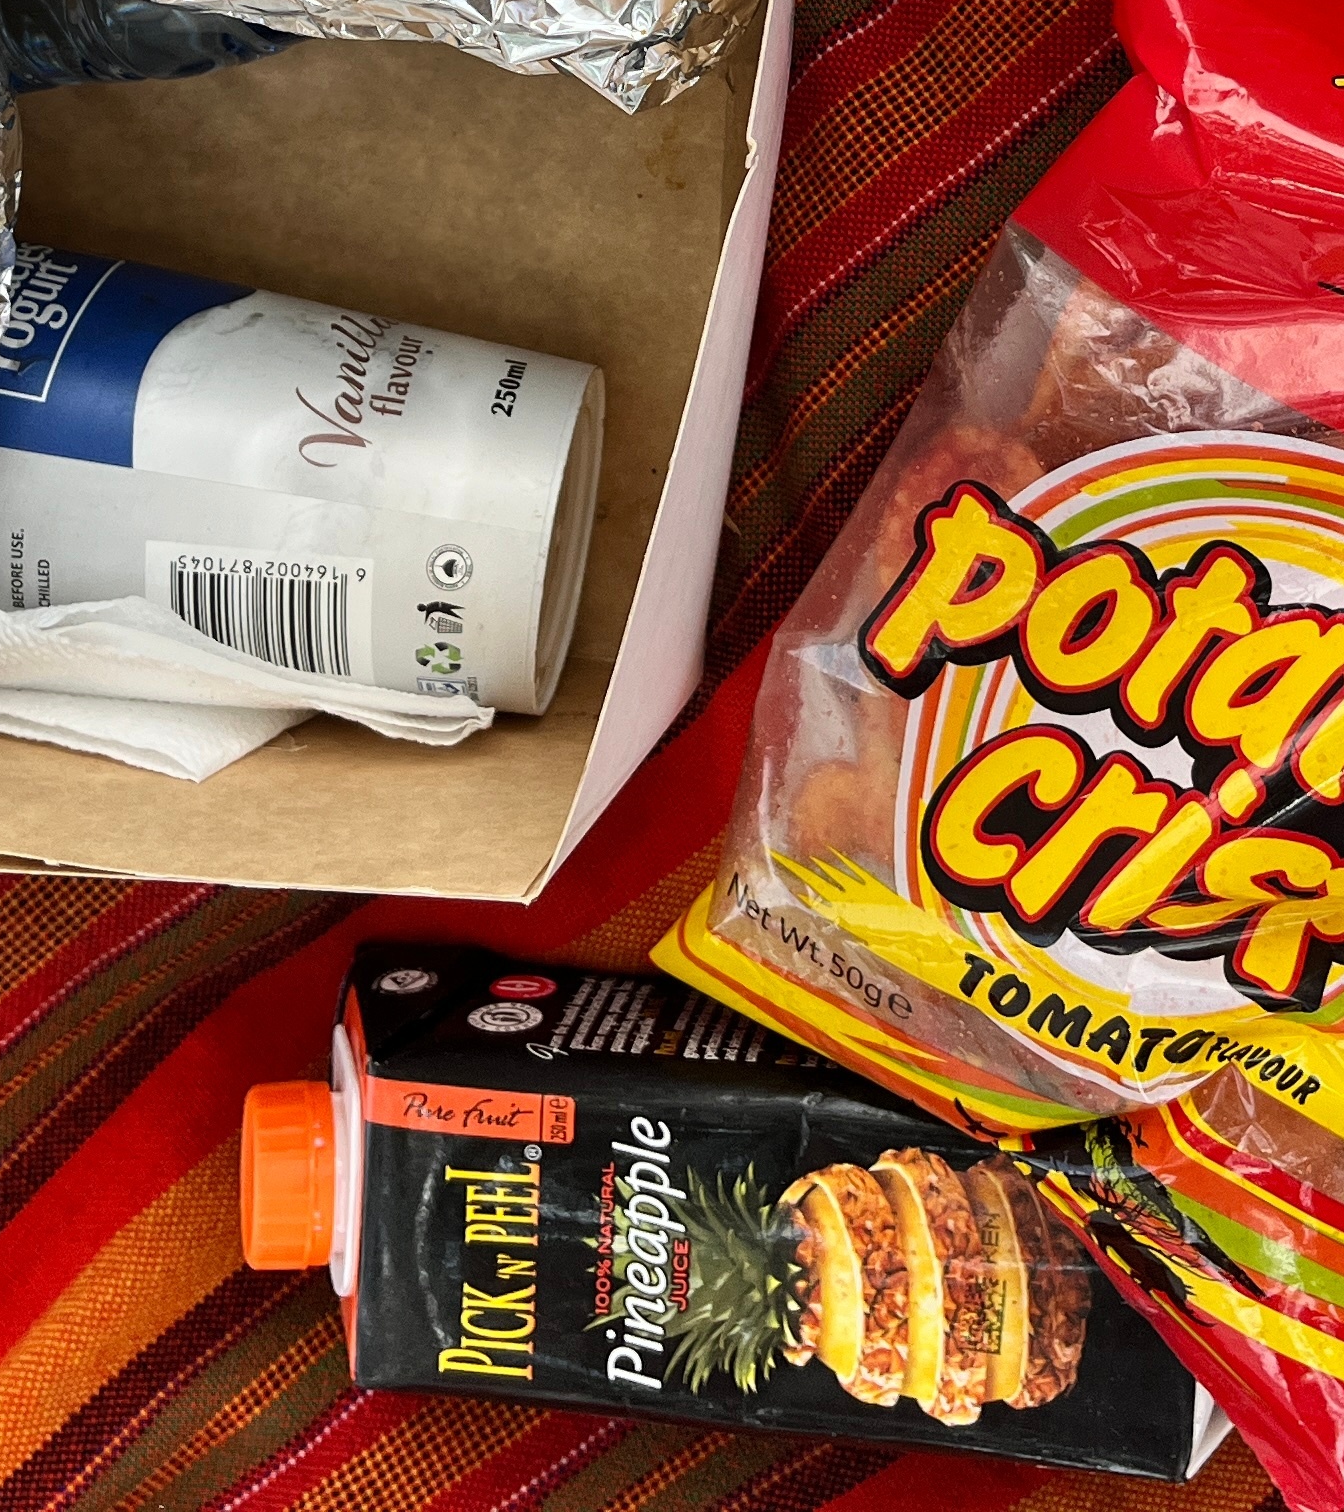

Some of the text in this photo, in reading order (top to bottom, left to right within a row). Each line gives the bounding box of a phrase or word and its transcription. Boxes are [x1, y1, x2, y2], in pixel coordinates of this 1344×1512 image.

[296, 314, 400, 468] Vanilla
[369, 335, 424, 417] flavour
[490, 359, 528, 418] 250ml
[10, 528, 25, 609] BEFORE USE.
[37, 559, 51, 608] CHILLED
[177, 554, 366, 582] 6 164002 871045
[726, 871, 772, 931] Net
[780, 916, 824, 968] Wt.
[957, 951, 1322, 1105] TOMATO FLAVOUR
[444, 1161, 541, 1246] PEEL
[594, 1161, 616, 1316] 100% NATURAL
[605, 1115, 688, 1390] Pineapple
[669, 1239, 691, 1312] JUICE
[438, 1282, 537, 1381] PICK
